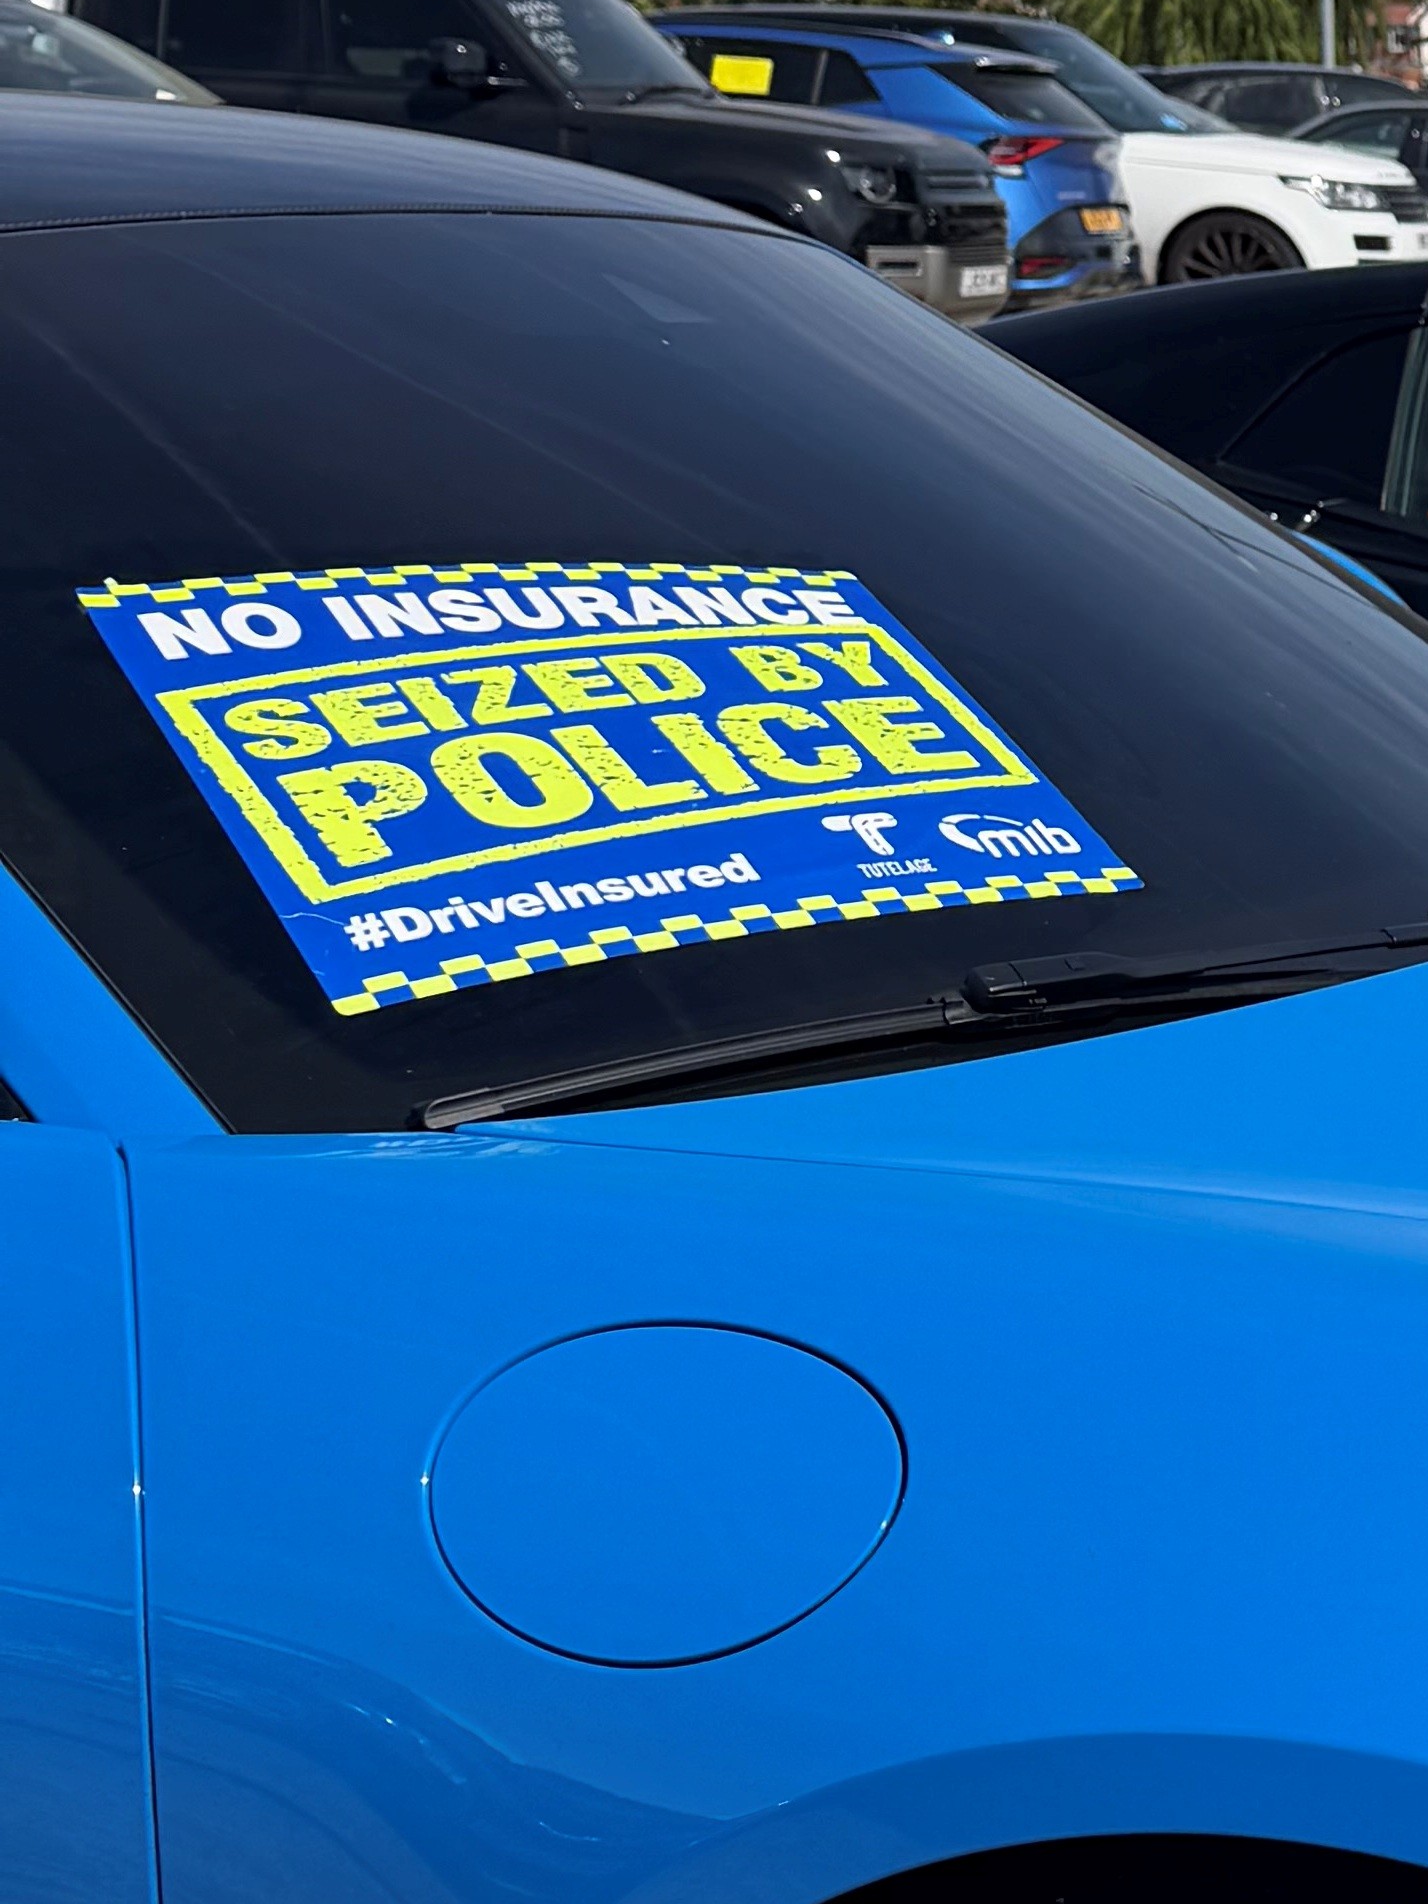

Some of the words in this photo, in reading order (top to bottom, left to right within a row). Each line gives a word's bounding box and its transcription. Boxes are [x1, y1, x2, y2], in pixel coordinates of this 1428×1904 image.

[137, 603, 301, 661] NO
[322, 587, 857, 641] INSURANCE
[224, 653, 706, 759] SEIZED
[732, 641, 890, 693] BY
[277, 696, 983, 867] POLICE
[857, 858, 938, 879] TUTELAGE
[978, 818, 1082, 858] mib
[343, 853, 761, 952] #DriveInsured
